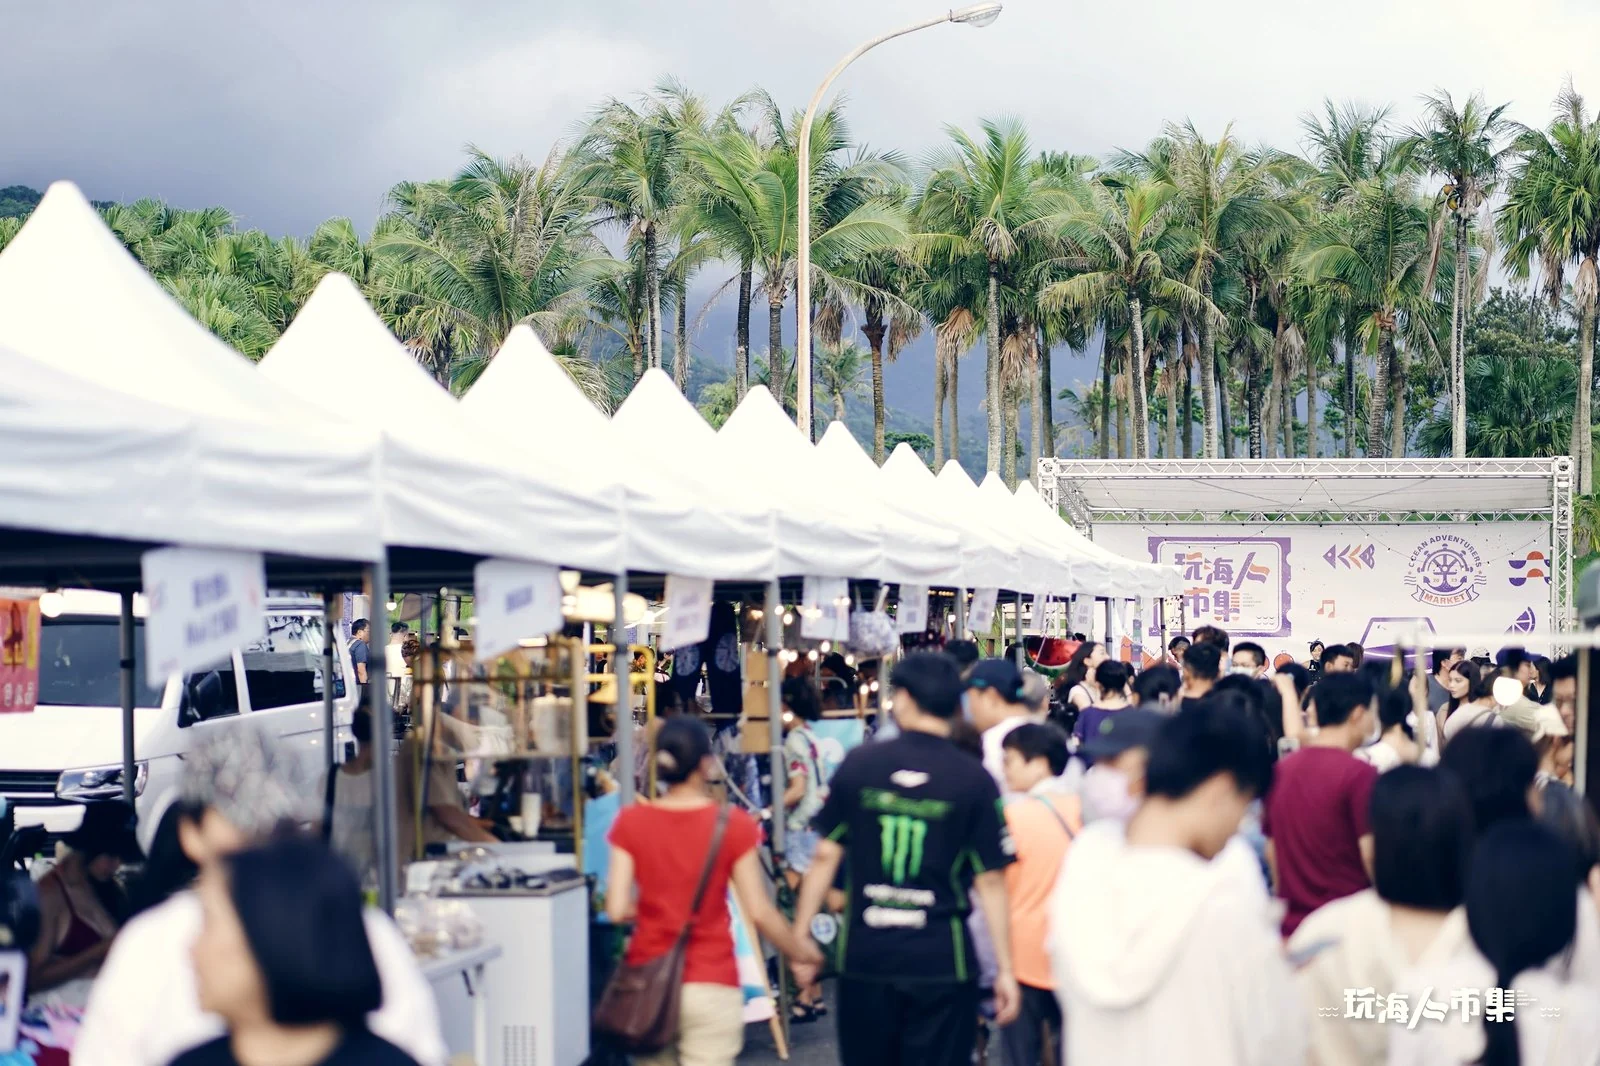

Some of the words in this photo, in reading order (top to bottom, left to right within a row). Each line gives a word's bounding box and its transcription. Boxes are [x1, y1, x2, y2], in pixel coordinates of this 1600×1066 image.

[1429, 534, 1482, 568] ADVENTURERS
[1175, 552, 1270, 590] 玩海人
[1183, 587, 1240, 622] 市集
[1424, 593, 1466, 605] MARKET
